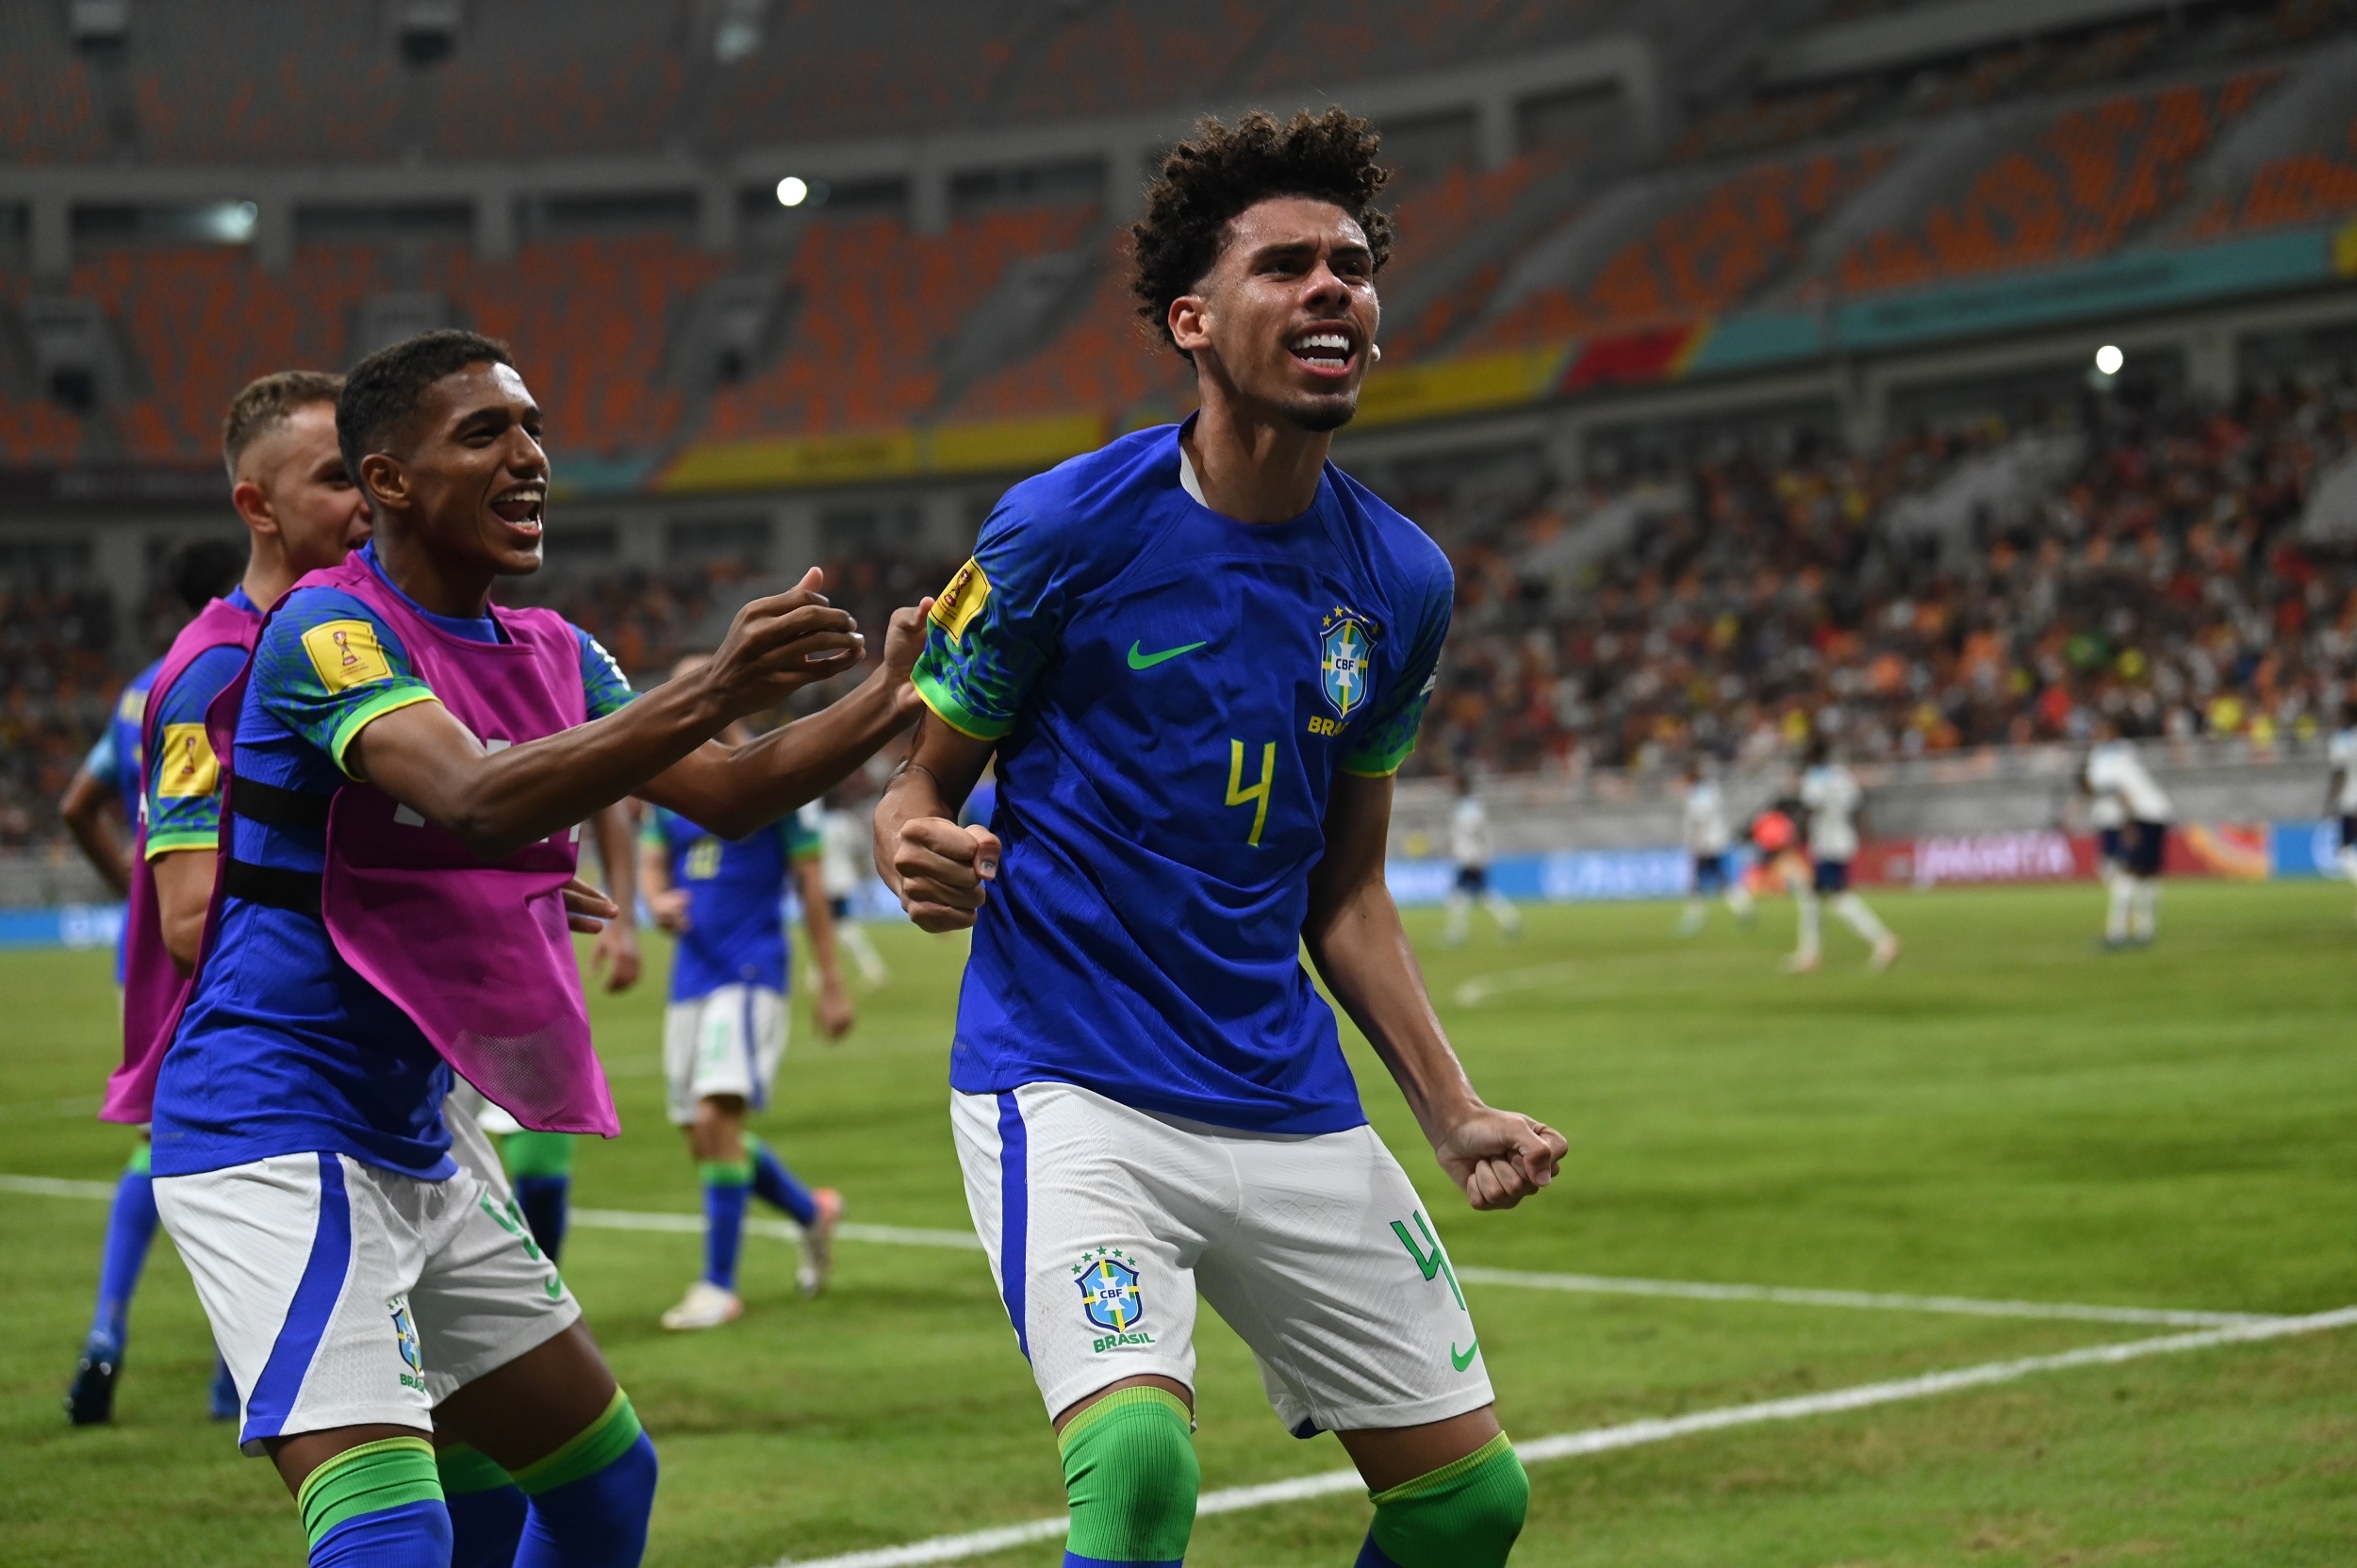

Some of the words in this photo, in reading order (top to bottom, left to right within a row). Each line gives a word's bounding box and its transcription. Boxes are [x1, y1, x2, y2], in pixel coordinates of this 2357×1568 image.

[1335, 658, 1355, 671] CBF
[1225, 737, 1277, 849] 4
[1389, 1210, 1466, 1312] 4
[1099, 1288, 1123, 1299] CBF
[1093, 1332, 1156, 1354] BRASIL
